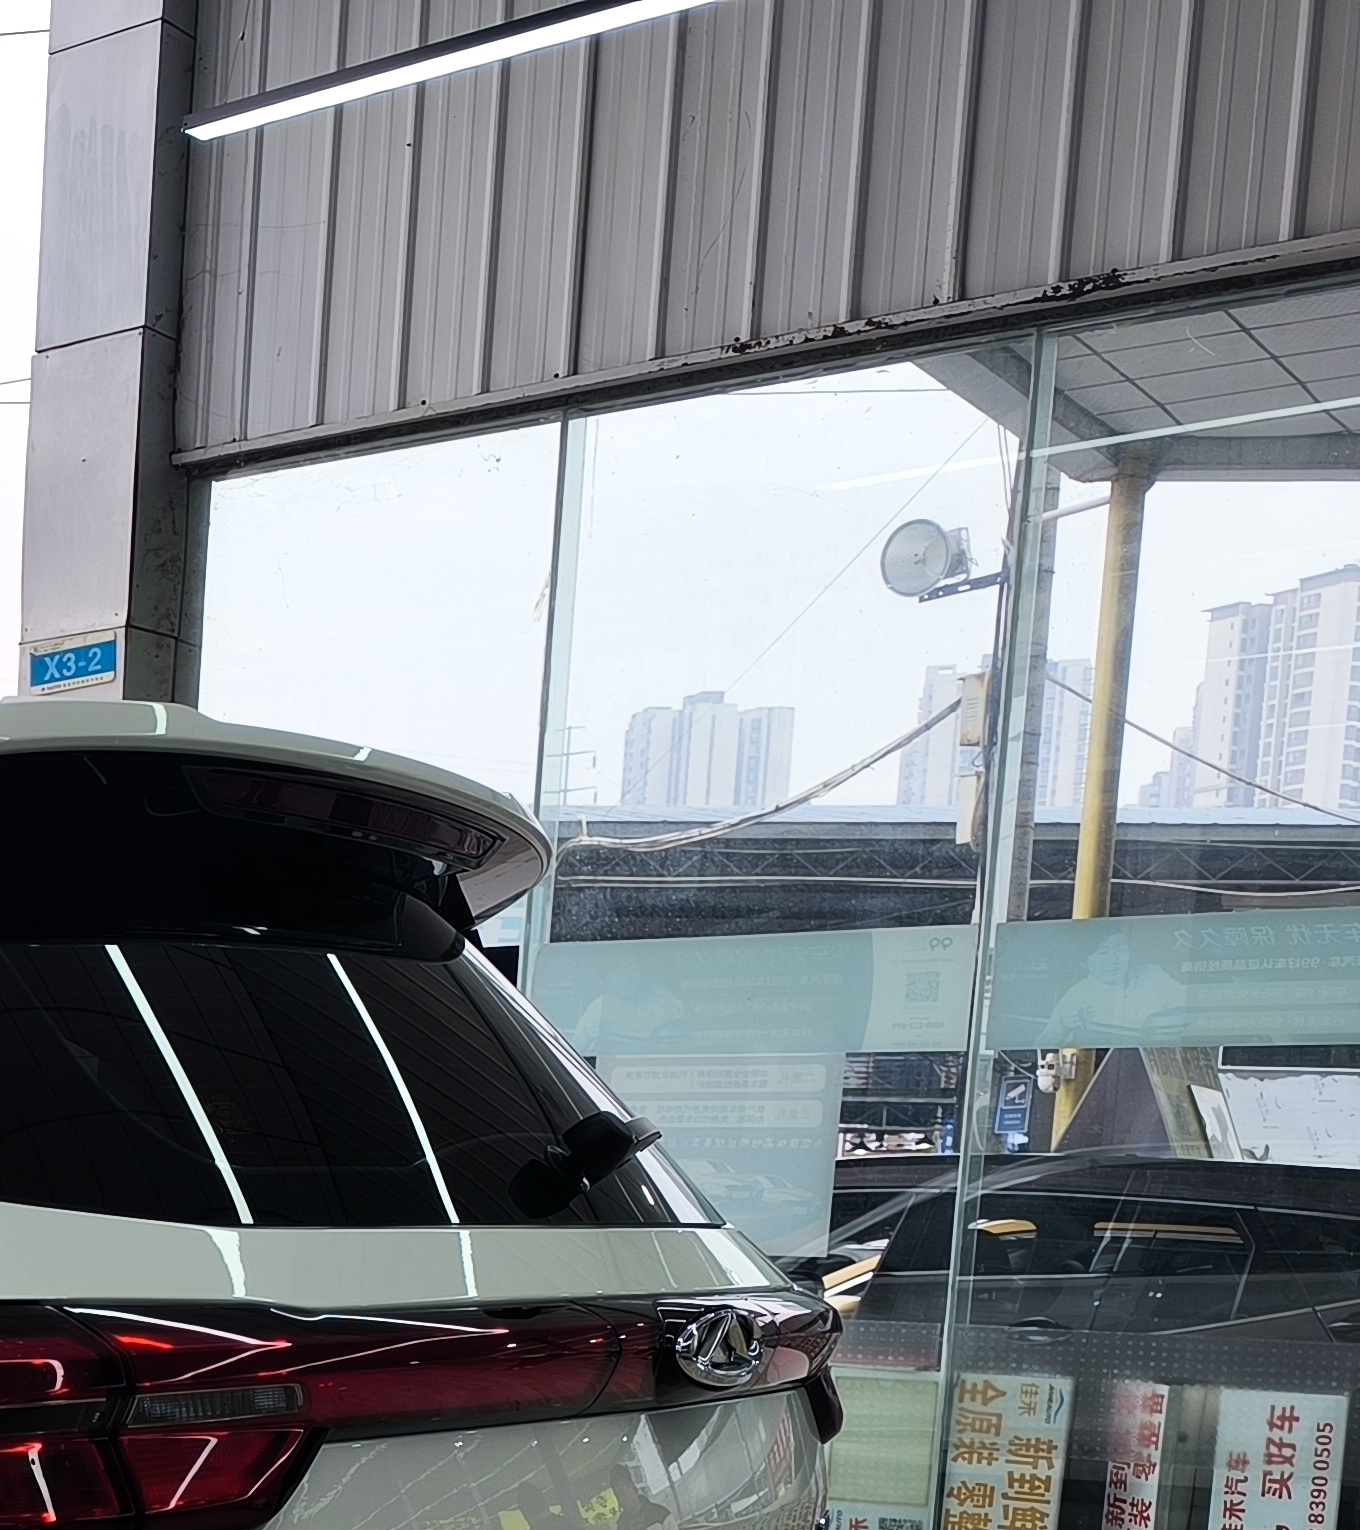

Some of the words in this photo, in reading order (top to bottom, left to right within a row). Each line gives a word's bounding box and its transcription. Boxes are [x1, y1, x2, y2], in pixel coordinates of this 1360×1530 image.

[43, 647, 102, 681] X3-2
[950, 1378, 1008, 1467] 全原装
[1018, 1383, 1040, 1418] 佳禾
[1311, 1422, 1334, 1471] 0505
[1307, 1476, 1329, 1525] 8390
